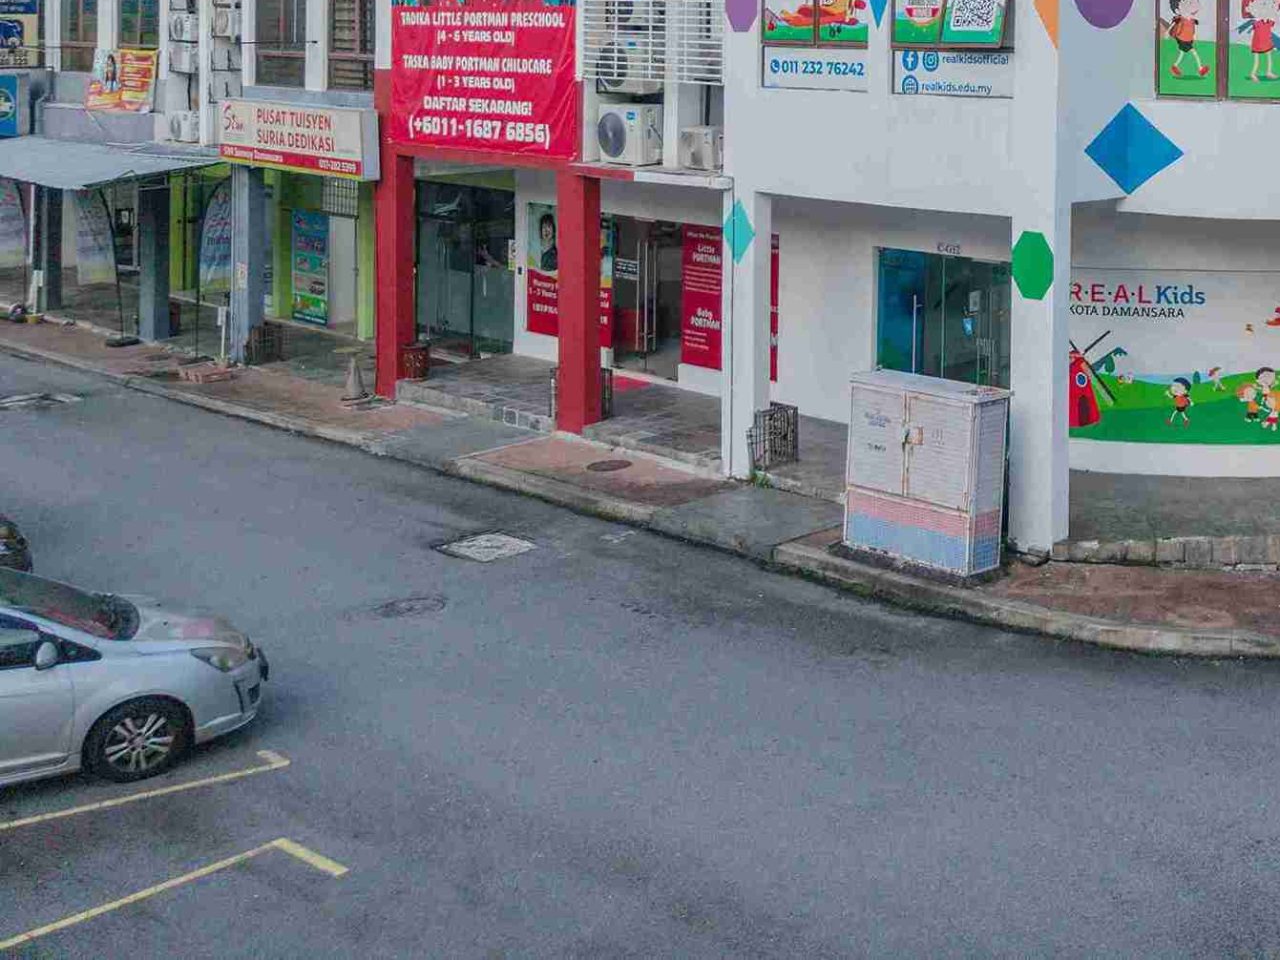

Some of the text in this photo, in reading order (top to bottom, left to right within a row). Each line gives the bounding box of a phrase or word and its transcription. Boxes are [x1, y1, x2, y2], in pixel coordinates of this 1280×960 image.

[401, 12, 565, 27] TADIKA LITTLE PORTMAN PRESCHOOL
[463, 31, 491, 42] YEARS
[403, 54, 552, 74] TASKA BABY PORTMAN CHILDCARE
[942, 53, 1009, 65] realkidsofficial
[782, 60, 864, 75] 011 232 76242
[454, 77, 461, 87] 3
[462, 77, 491, 88] YEARS
[921, 81, 992, 95] realkids.edu.my
[423, 96, 532, 115] DAFTAR SEKARANG!
[257, 108, 286, 127] PUSAT
[290, 111, 332, 130] TUISYEN
[256, 129, 335, 152] SURIA DEDIKASI
[506, 121, 550, 150] 6856)
[1155, 284, 1206, 305] Kids
[1102, 305, 1185, 318] DAMANSARA
